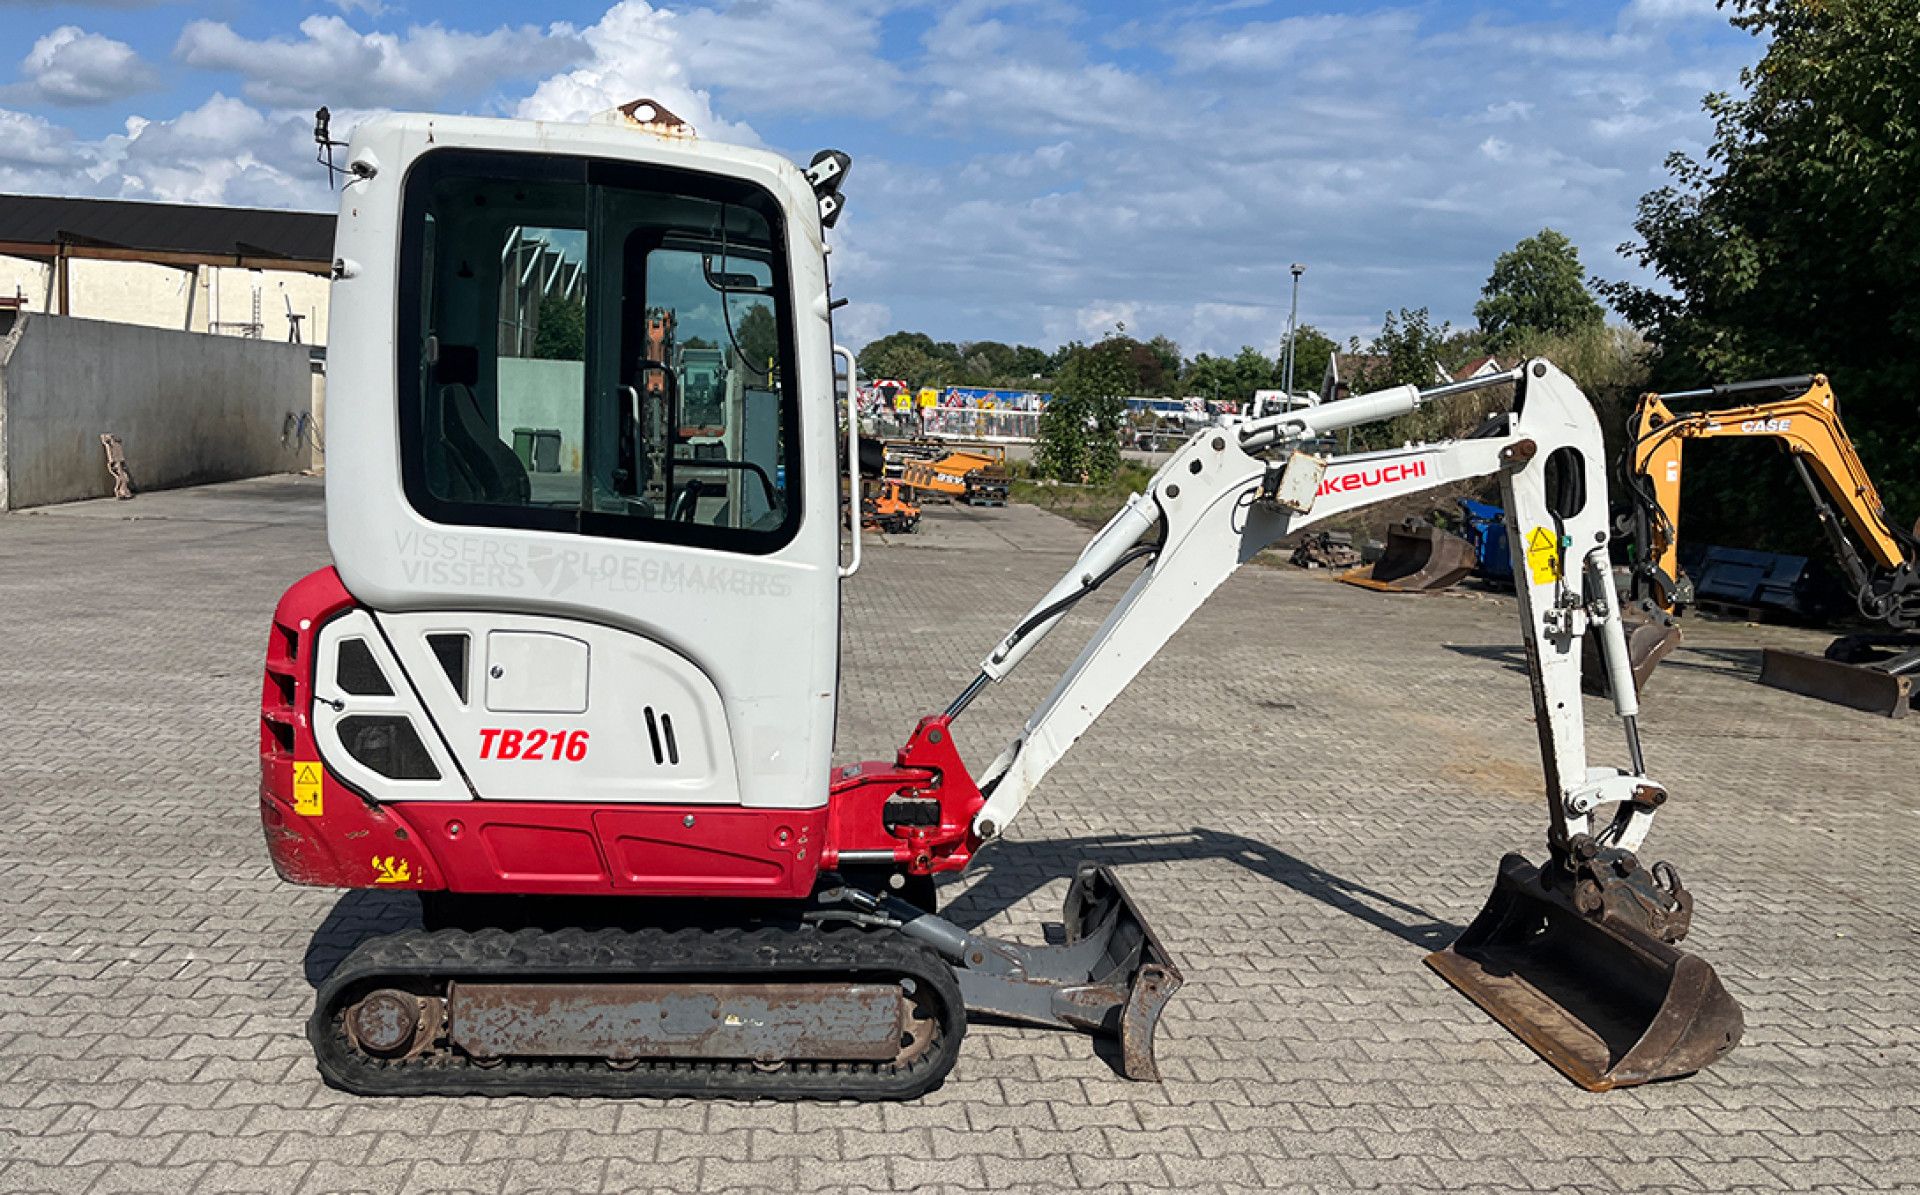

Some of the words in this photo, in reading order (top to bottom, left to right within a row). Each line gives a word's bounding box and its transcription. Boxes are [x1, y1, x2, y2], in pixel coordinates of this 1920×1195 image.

[1742, 419, 1791, 433] CASE
[394, 529, 520, 567] VISSERS
[401, 559, 526, 588] VISSERS
[479, 728, 590, 762] TB216
